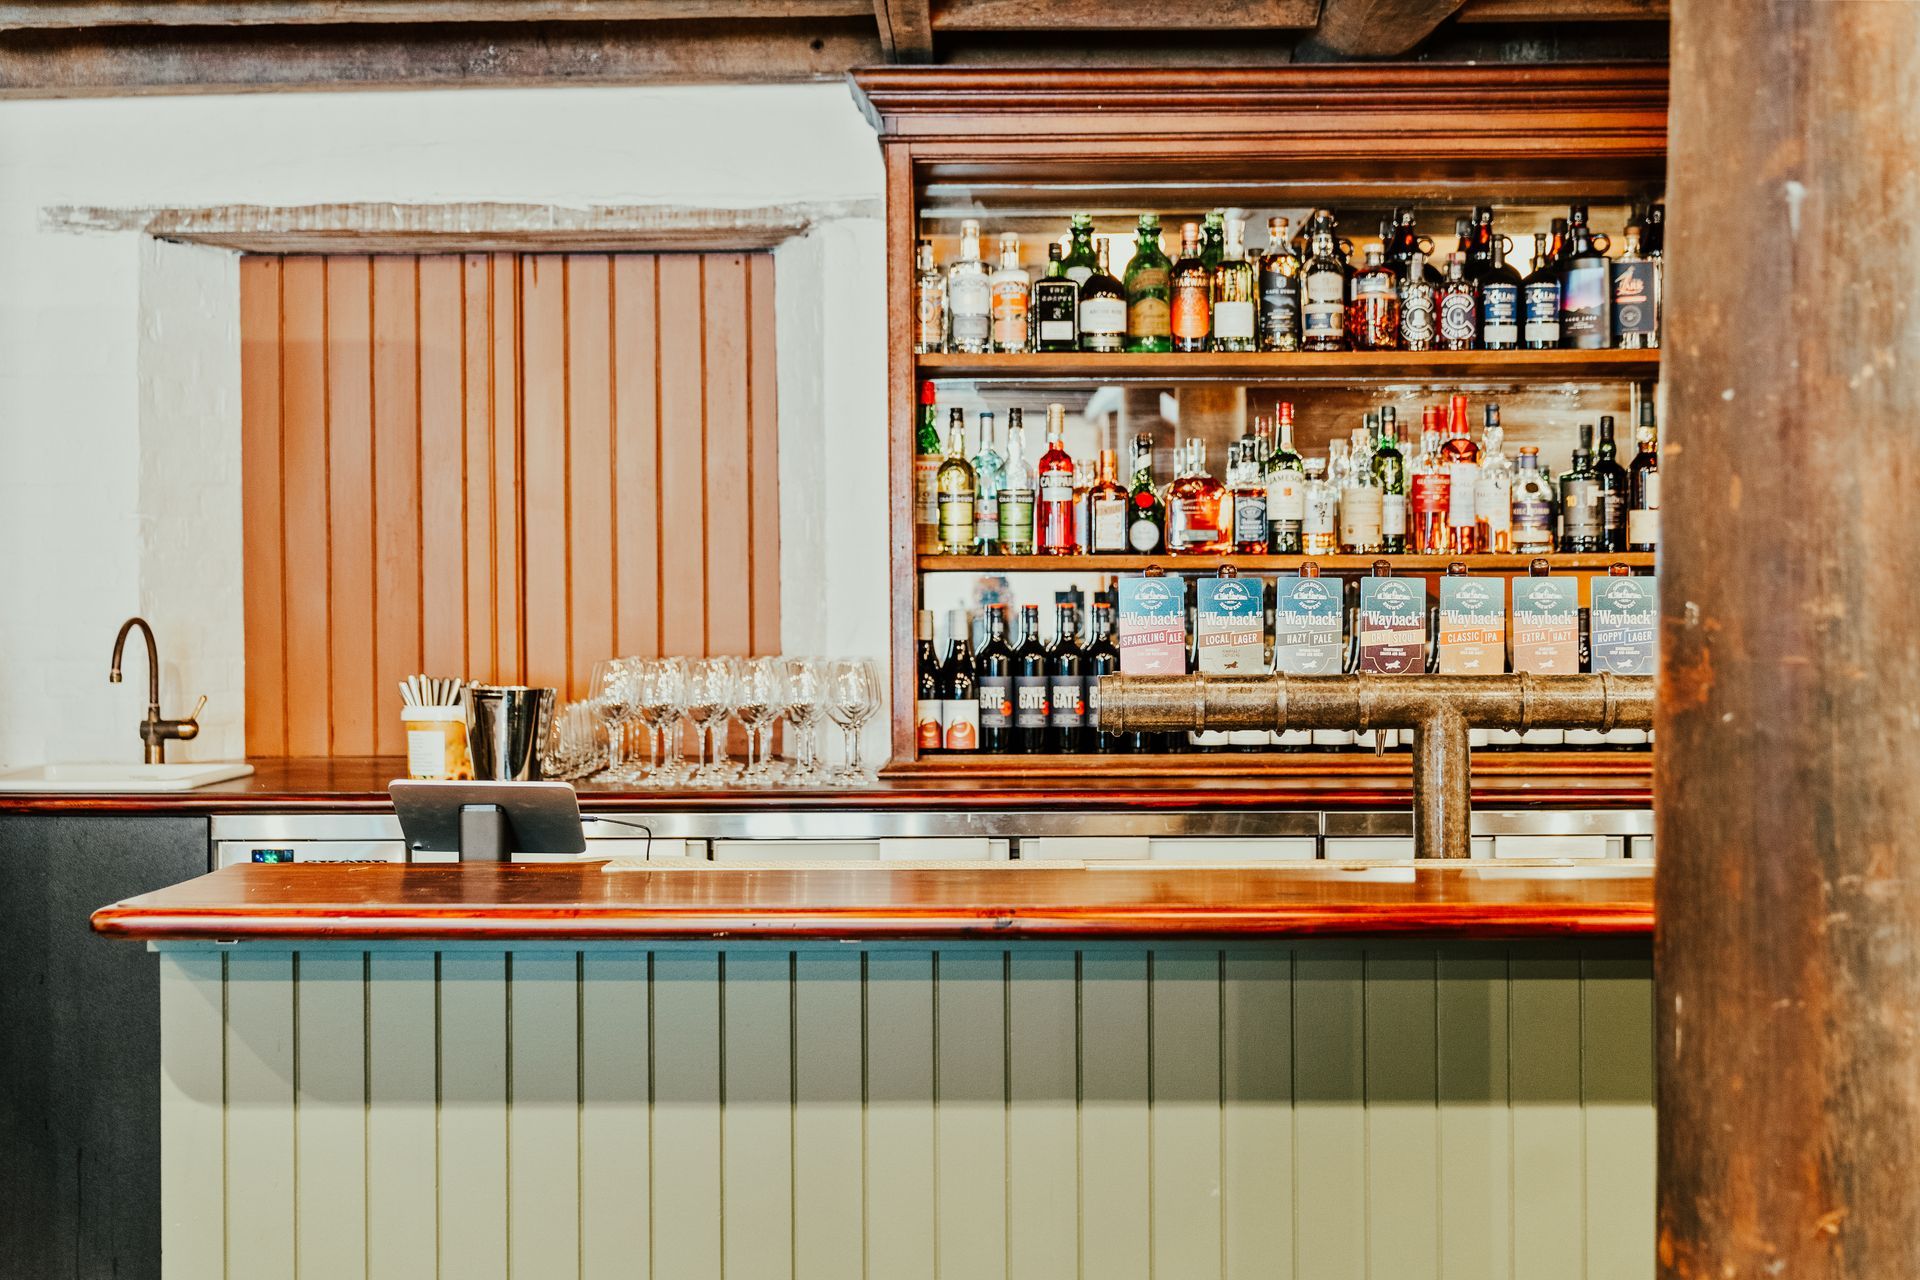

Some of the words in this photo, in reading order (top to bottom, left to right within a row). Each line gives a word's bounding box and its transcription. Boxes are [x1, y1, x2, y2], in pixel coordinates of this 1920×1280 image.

[1123, 632, 1165, 646] SPARKLING
[1169, 632, 1182, 643] ALE
[1206, 634, 1229, 646] LOCAL
[1233, 633, 1258, 645] LAGER
[1286, 633, 1306, 644] HAZY
[1313, 634, 1333, 644] PALE
[1371, 632, 1387, 643] DRY
[1393, 632, 1416, 644] STOUT
[1447, 632, 1479, 643] CLASSIC
[1484, 632, 1498, 642] IPA
[1522, 631, 1546, 643] EXTRA
[1552, 631, 1571, 641] HAZY
[1598, 631, 1623, 643] HOPPY
[1628, 631, 1652, 642] LAGER
[1018, 693, 1046, 709] GATE
[1053, 693, 1080, 709] GATE
